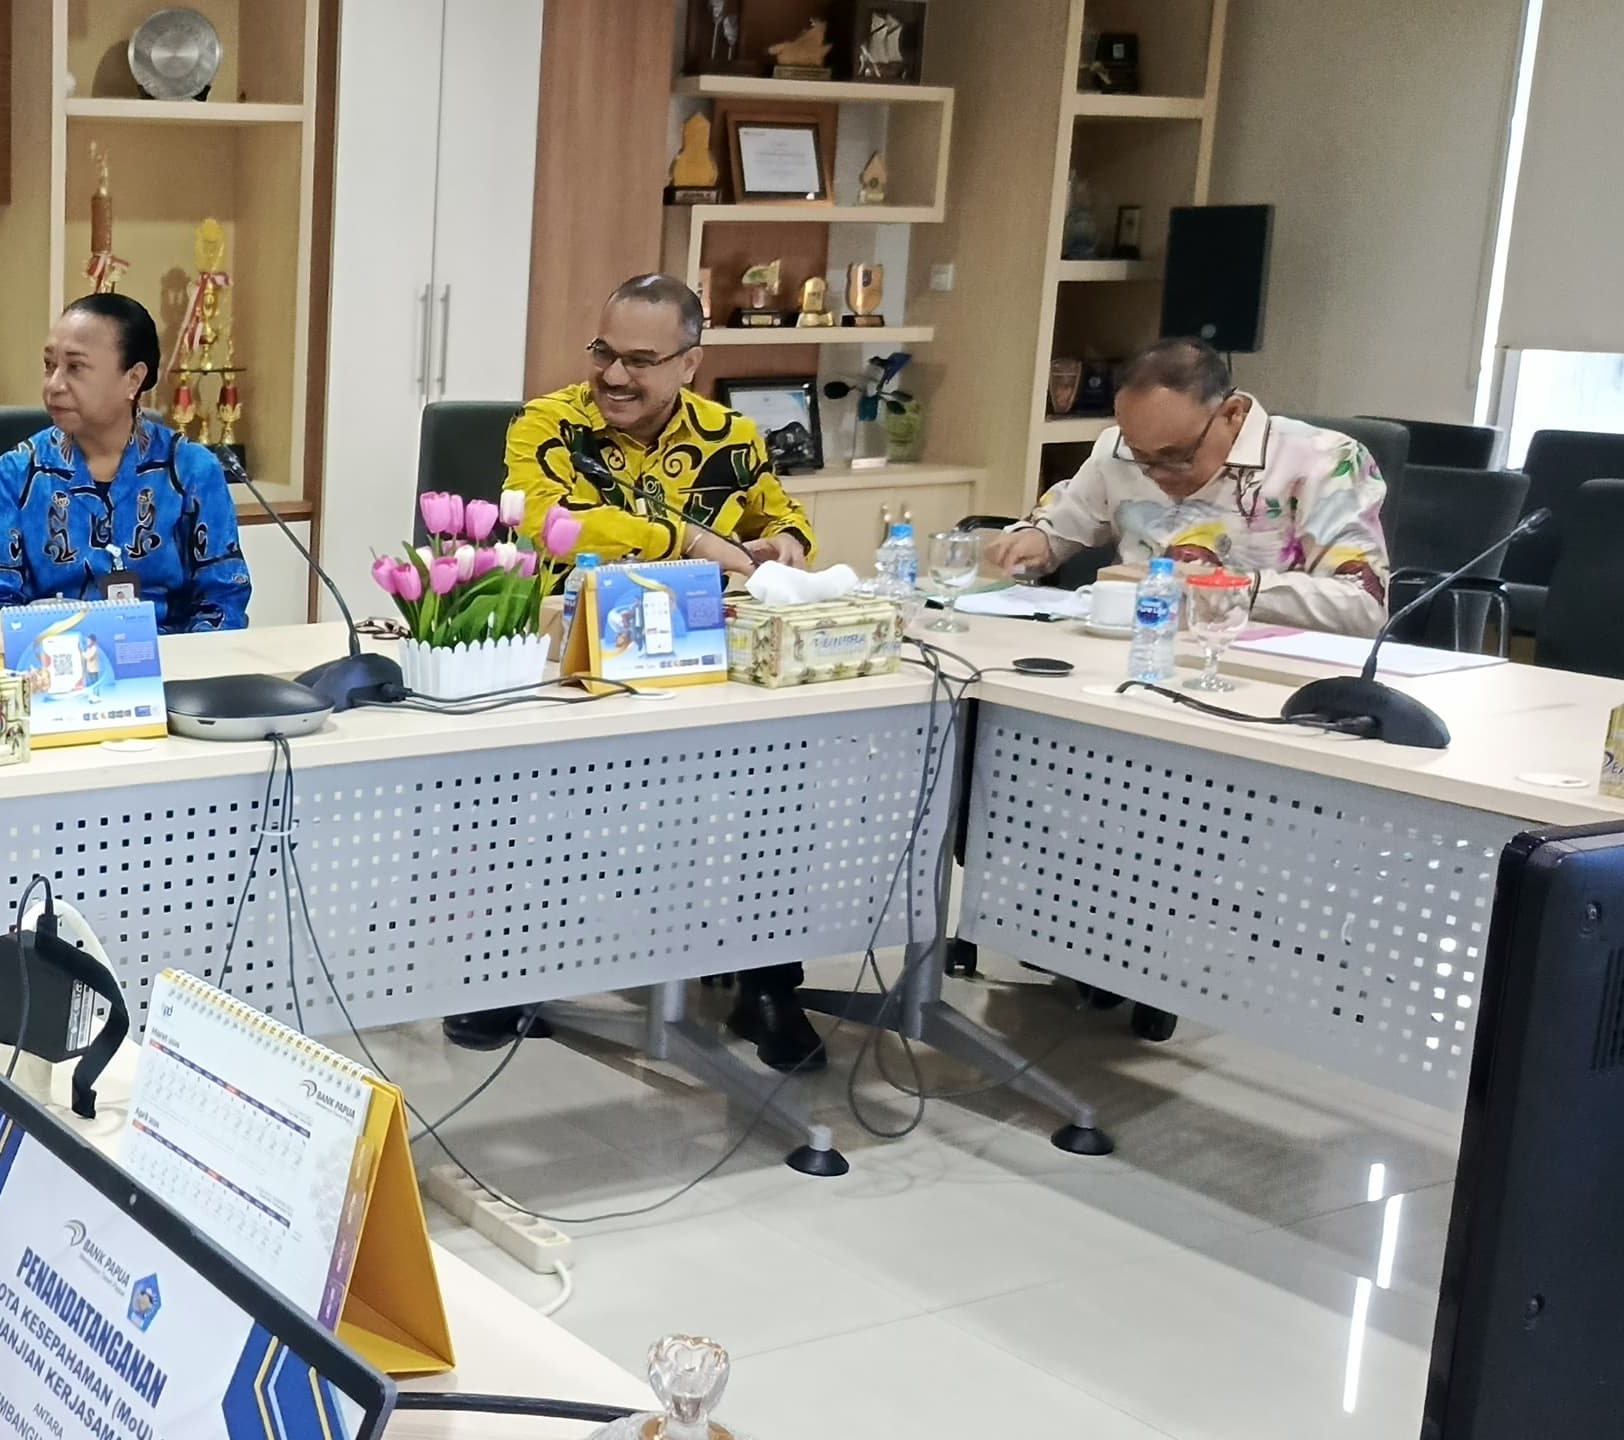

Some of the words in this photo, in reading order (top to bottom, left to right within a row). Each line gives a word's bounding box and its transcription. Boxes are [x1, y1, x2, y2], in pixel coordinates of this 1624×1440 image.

[316, 1091, 336, 1107] BANK
[334, 1101, 356, 1119] PAPUA
[82, 1238, 106, 1266] BANK
[103, 1255, 131, 1289] PAPUA
[16, 1245, 168, 1409] PENANDATANGANAN
[19, 1305, 113, 1407] KESEPAHAMAN
[32, 1402, 65, 1439] ANTARA
[44, 1366, 122, 1440] KERJASAM
